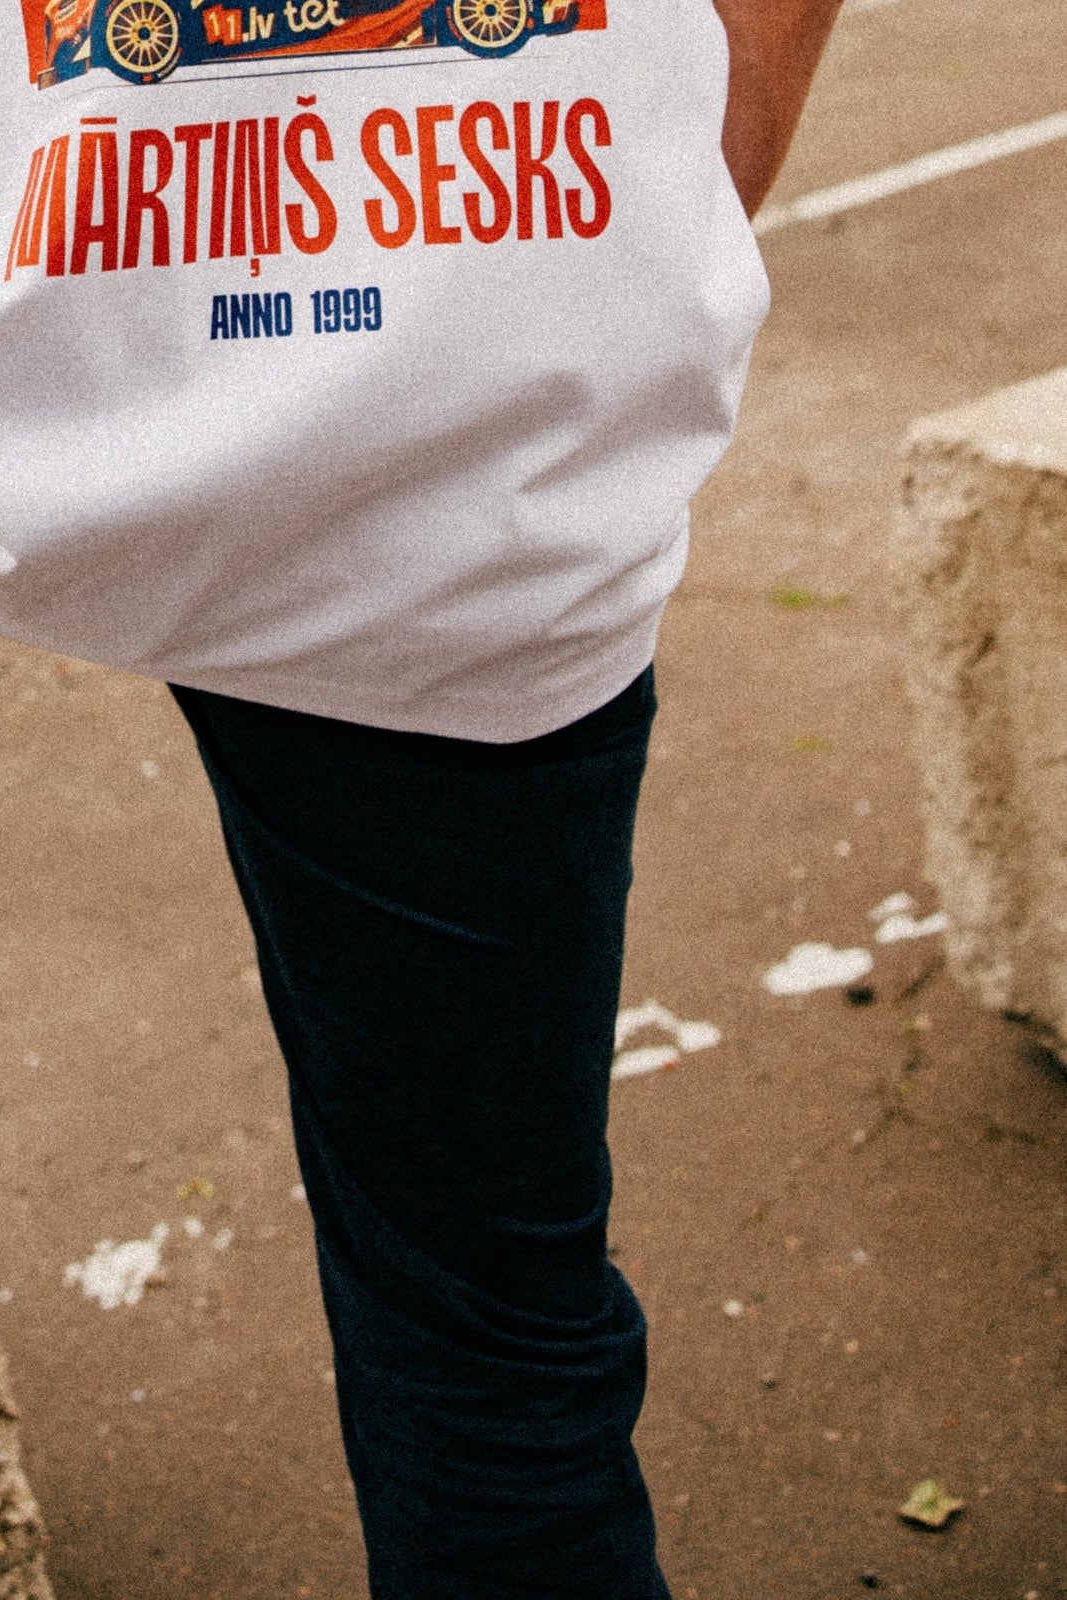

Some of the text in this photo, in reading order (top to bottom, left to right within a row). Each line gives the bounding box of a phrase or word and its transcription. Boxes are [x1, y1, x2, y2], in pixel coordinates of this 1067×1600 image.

[206, 5, 275, 44] 11.lv
[4, 95, 613, 282] MĀRTIŅŠ SESKS
[210, 286, 383, 340] ANNO 1999
